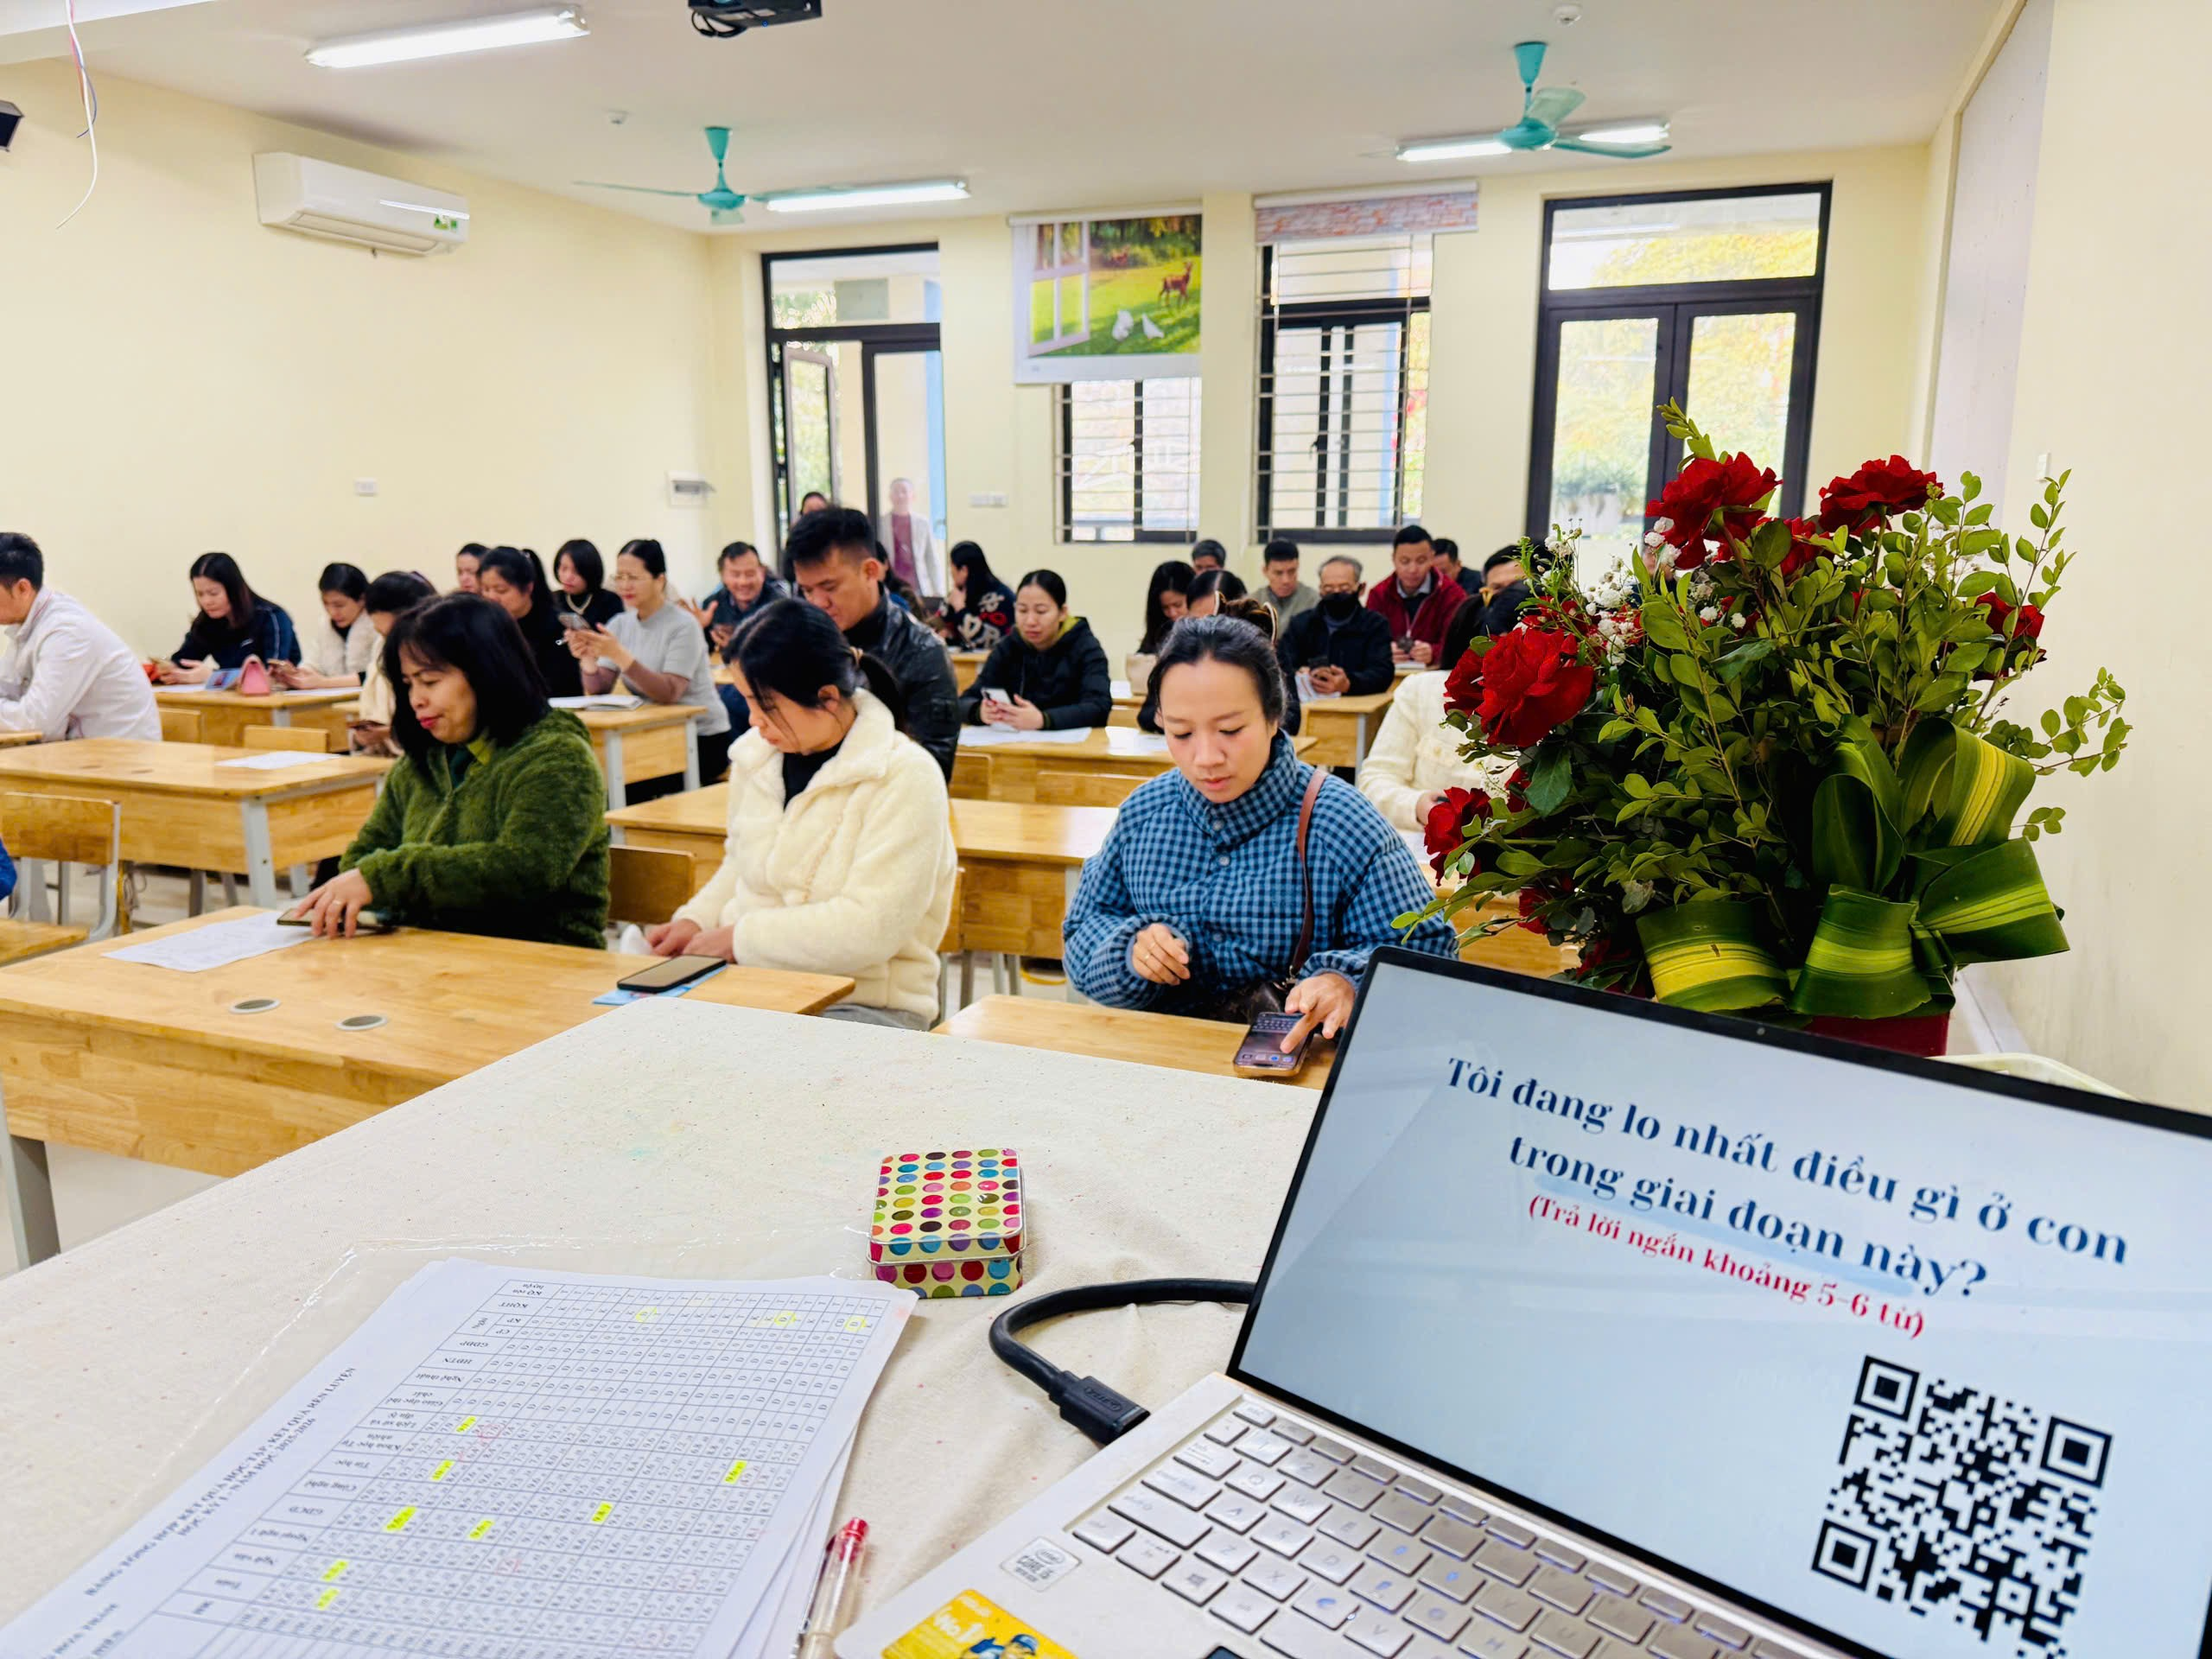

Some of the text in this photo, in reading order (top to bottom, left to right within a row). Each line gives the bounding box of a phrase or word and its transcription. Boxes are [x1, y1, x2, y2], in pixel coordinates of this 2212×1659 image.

[1448, 1057, 2127, 1265] Tôi đang lo nhất điều gì ở con
[1510, 1136, 1987, 1296] trong giai đoạn này?
[1529, 1194, 1581, 1228] (Trả
[1588, 1213, 1621, 1240] lời
[1628, 1230, 1694, 1263] ngắn
[1703, 1249, 1812, 1304] khoảng
